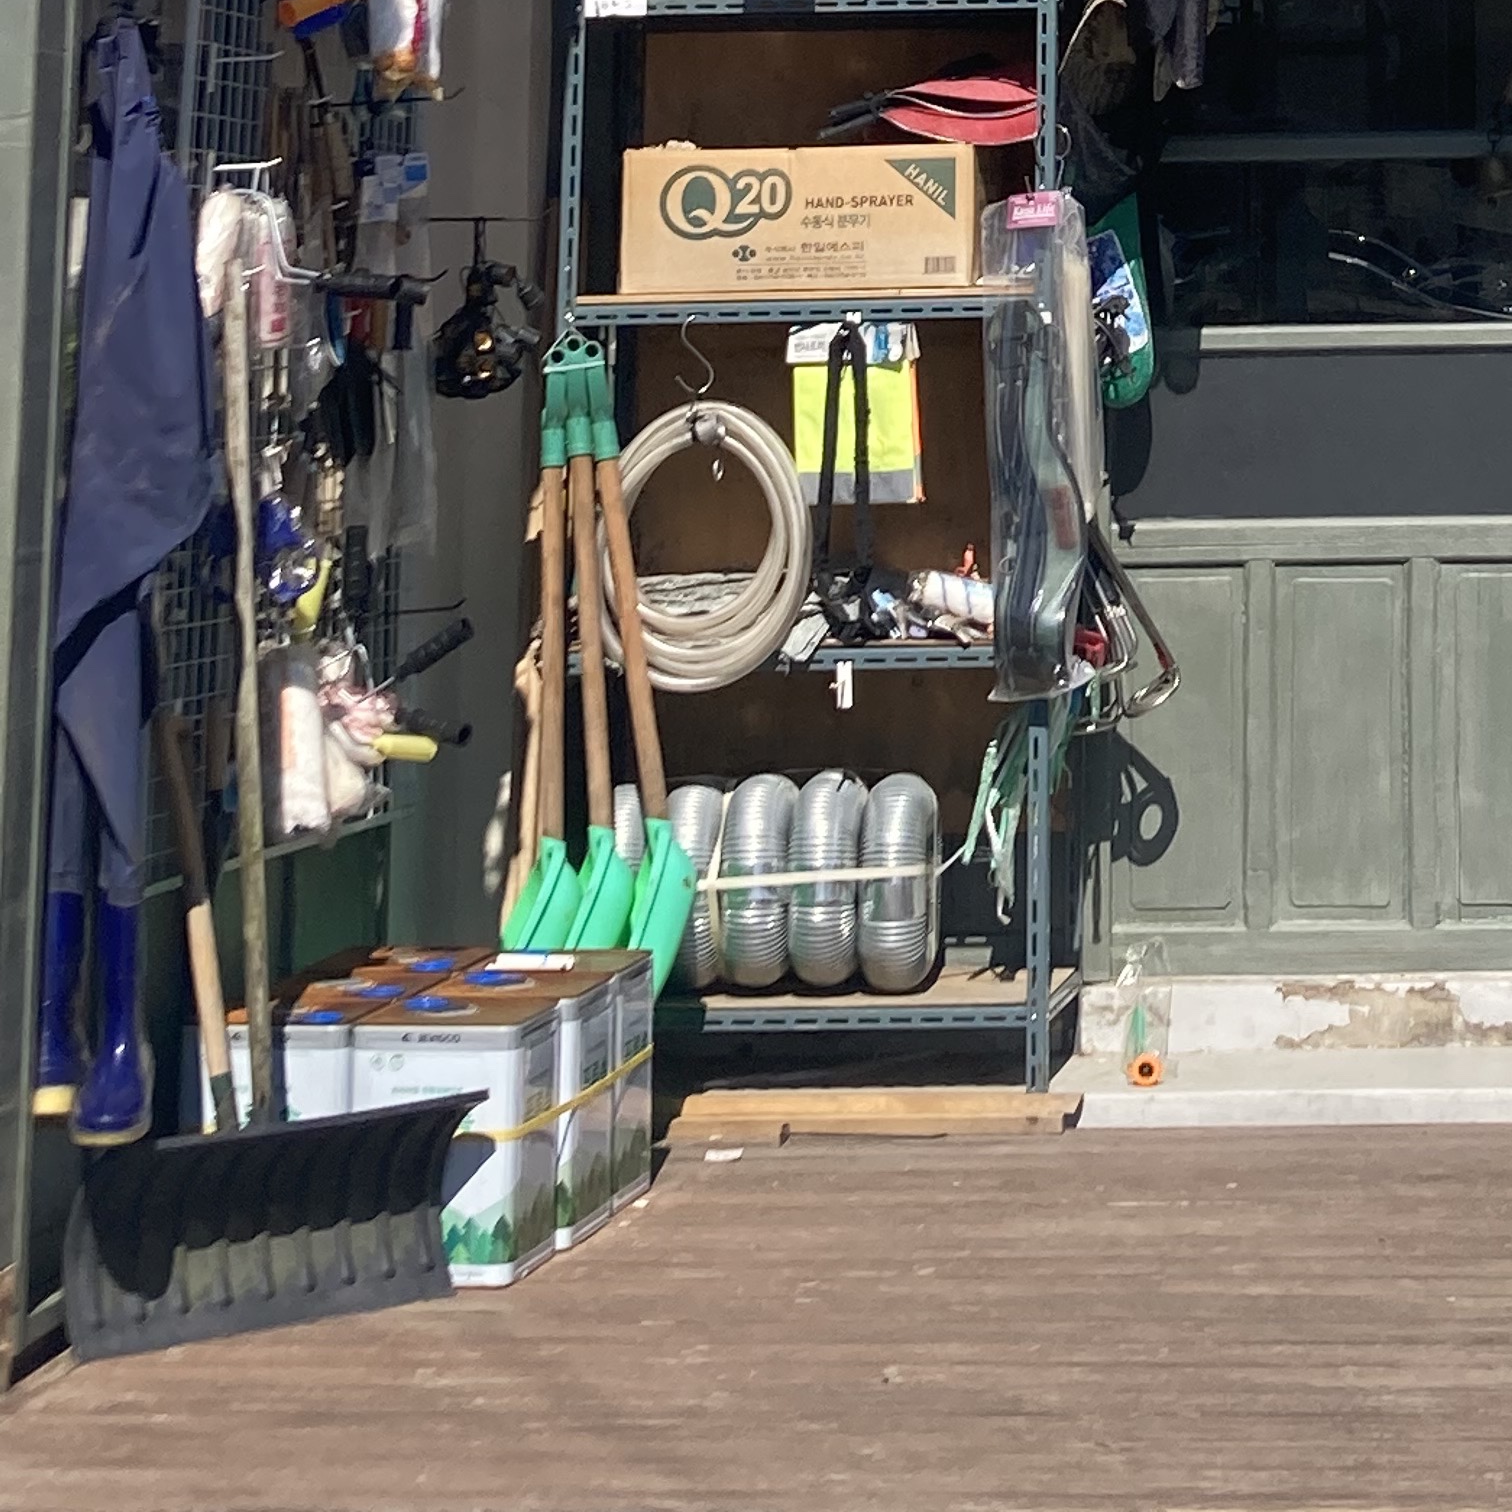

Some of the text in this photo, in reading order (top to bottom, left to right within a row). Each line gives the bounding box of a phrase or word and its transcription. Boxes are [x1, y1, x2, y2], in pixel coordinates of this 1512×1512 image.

[903, 163, 948, 207] HANIL
[662, 167, 790, 239] Q20
[804, 194, 914, 211] HAND-SPRAYER
[800, 215, 834, 230] 수동식
